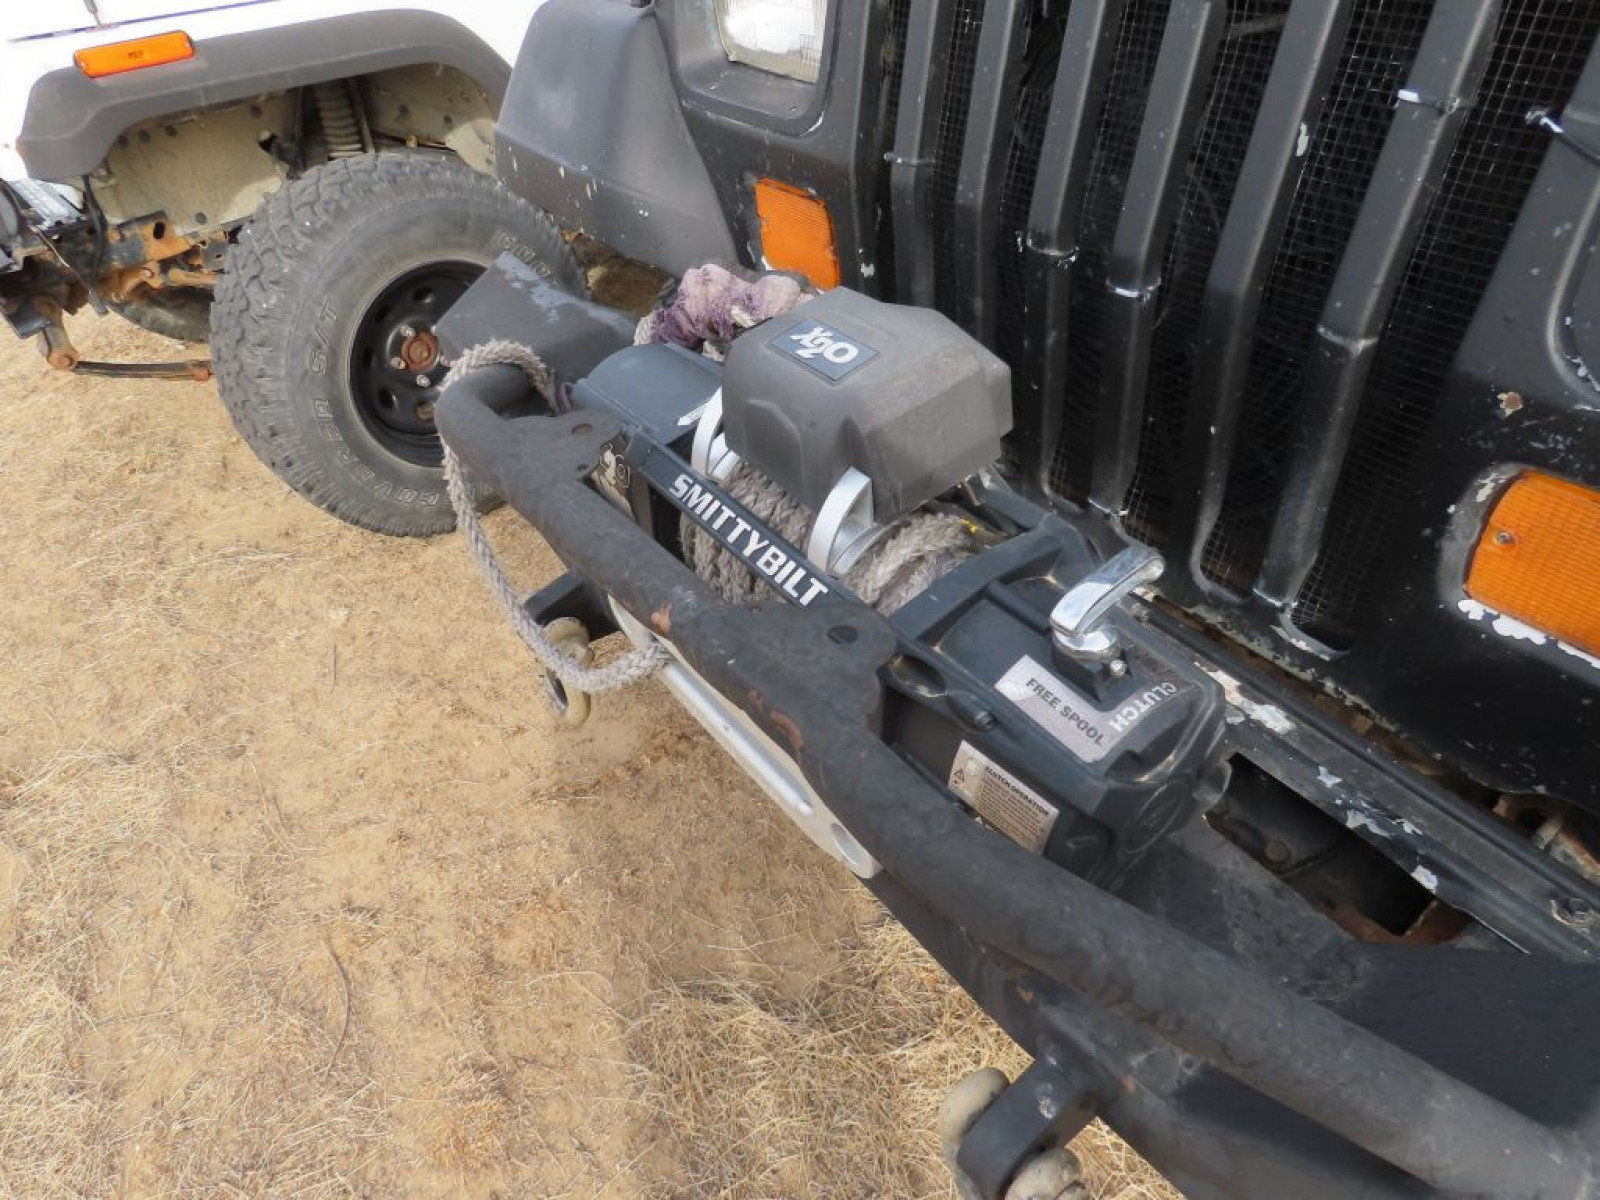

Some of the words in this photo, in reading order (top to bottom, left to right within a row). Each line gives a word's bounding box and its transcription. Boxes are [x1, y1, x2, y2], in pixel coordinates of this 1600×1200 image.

[309, 299, 338, 376] S/T
[668, 474, 829, 607] SMITTYBILT
[1025, 677, 1062, 710] FREE
[1059, 705, 1104, 746] SPOOL
[1109, 681, 1178, 732] CLUTCH
